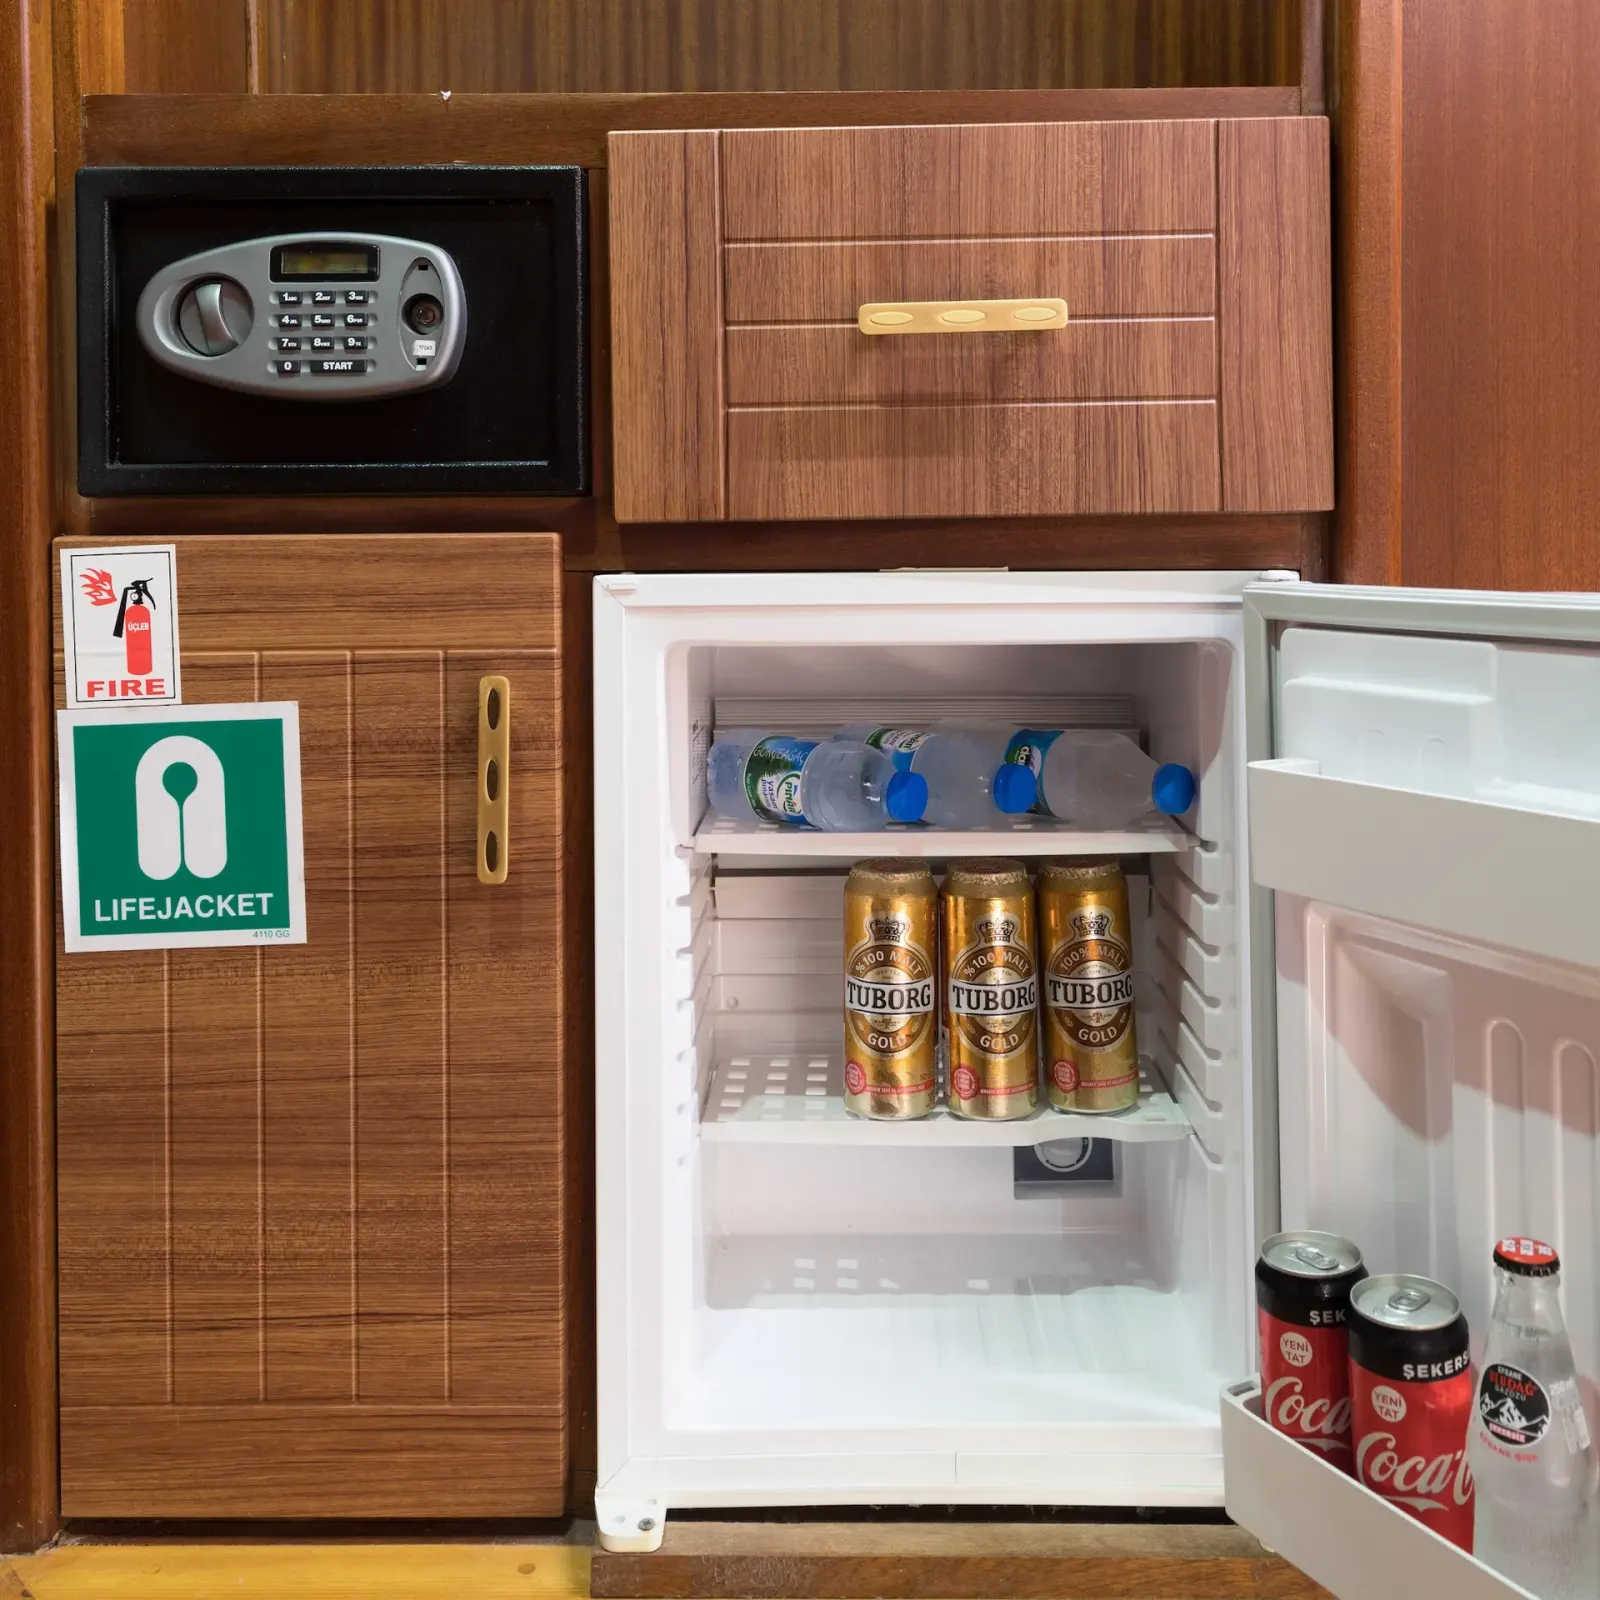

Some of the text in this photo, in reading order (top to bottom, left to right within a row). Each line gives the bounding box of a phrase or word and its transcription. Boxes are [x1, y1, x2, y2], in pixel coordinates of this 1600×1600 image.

[323, 362, 353, 370] START
[127, 621, 150, 633] ÜÇLER
[86, 679, 166, 699] FIRE
[94, 893, 274, 922] LIFEJACKET
[252, 930, 290, 938] 4110 GG
[855, 951, 885, 974] %100
[889, 951, 923, 975] MALT
[963, 952, 1030, 977] %100 MALT
[1060, 947, 1091, 971] 100%
[1096, 945, 1125, 967] MALT
[847, 980, 931, 1011] TUBORG
[952, 982, 1035, 1011] TUBORG
[1048, 975, 1133, 1004] TUBORG
[867, 1033, 907, 1049] GOLD
[980, 1033, 1019, 1050] GOLD
[1078, 1026, 1117, 1043] GOLD
[1285, 1350, 1306, 1365] TAT
[1378, 1404, 1400, 1420] TAT
